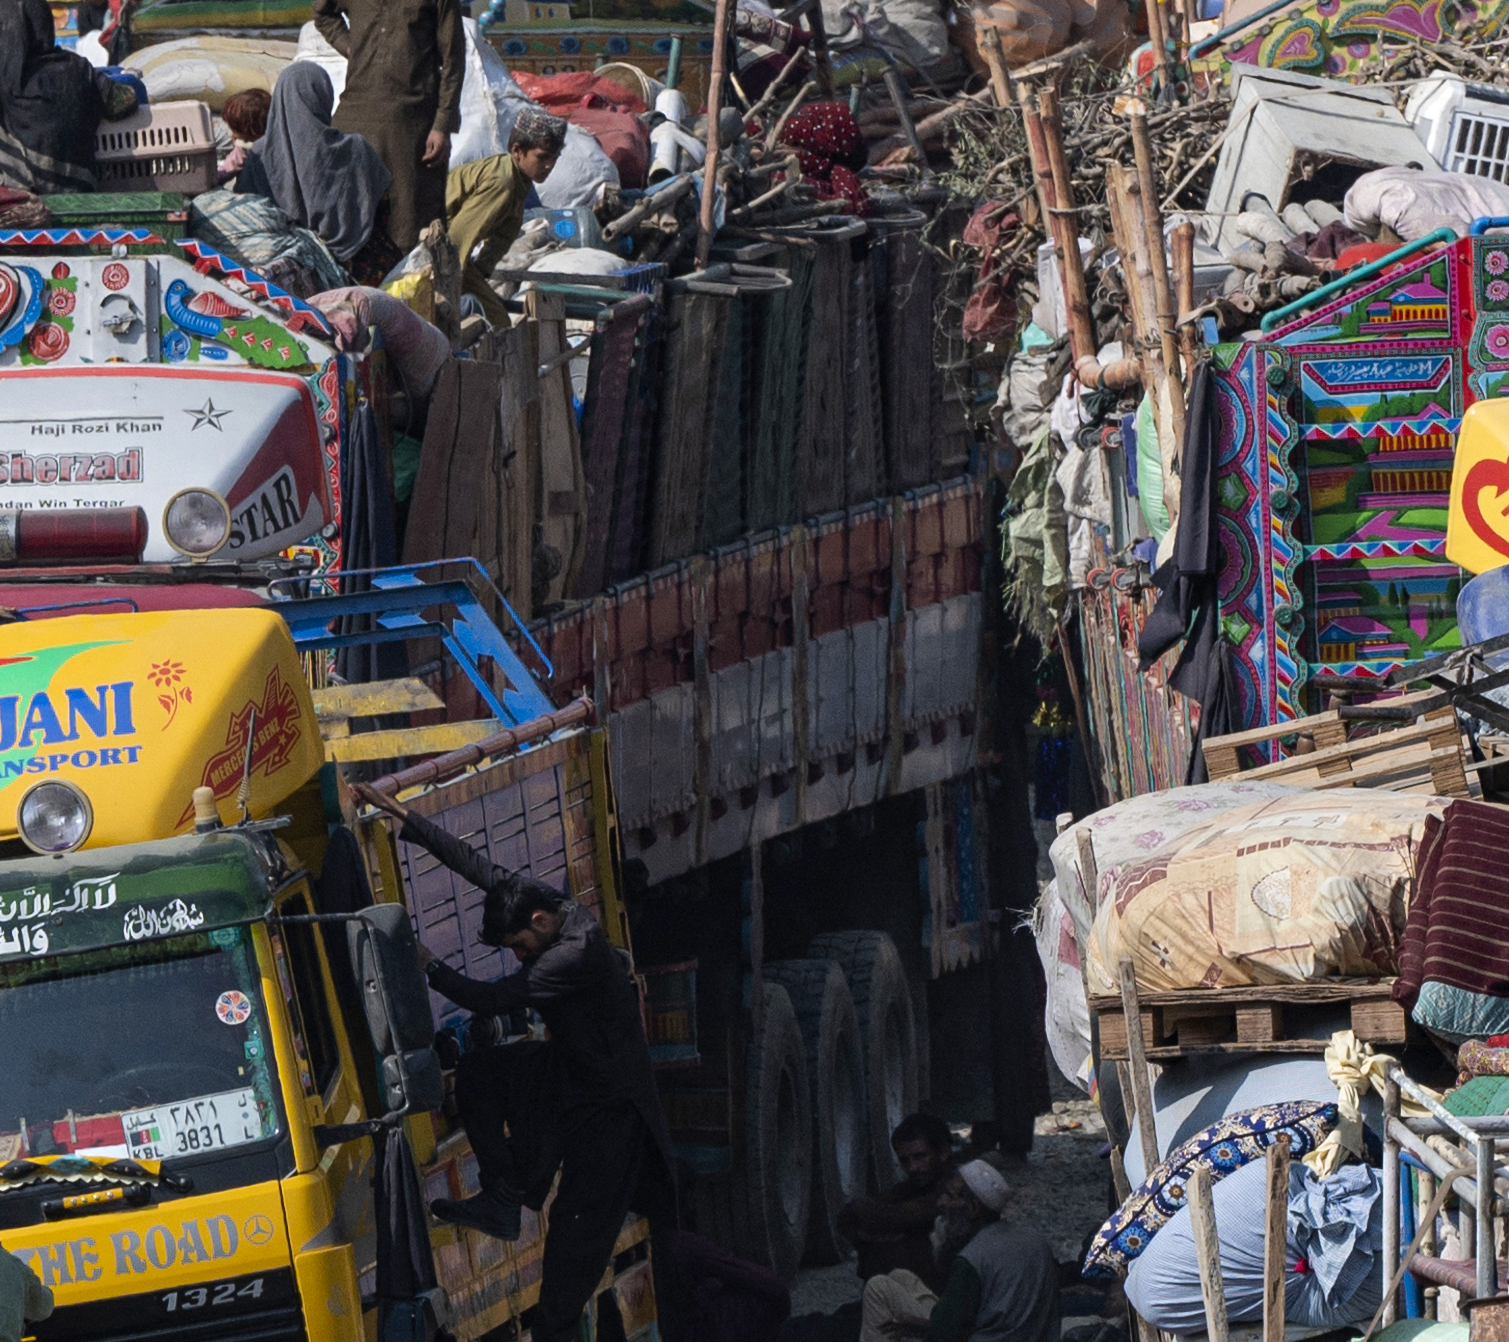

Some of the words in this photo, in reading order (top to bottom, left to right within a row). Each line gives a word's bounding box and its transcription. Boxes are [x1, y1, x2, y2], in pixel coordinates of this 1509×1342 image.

[31, 423, 66, 436] Haji
[71, 422, 109, 435] Rozi
[116, 421, 163, 433] Khan
[39, 498, 68, 509] Win
[229, 473, 302, 550] STAR
[255, 717, 282, 749] BENZ
[175, 1123, 226, 1153] 3831
[244, 1126, 255, 1140] L
[133, 1145, 165, 1159] KBL
[110, 1214, 239, 1277] ROAD
[162, 1277, 265, 1313] 1324
